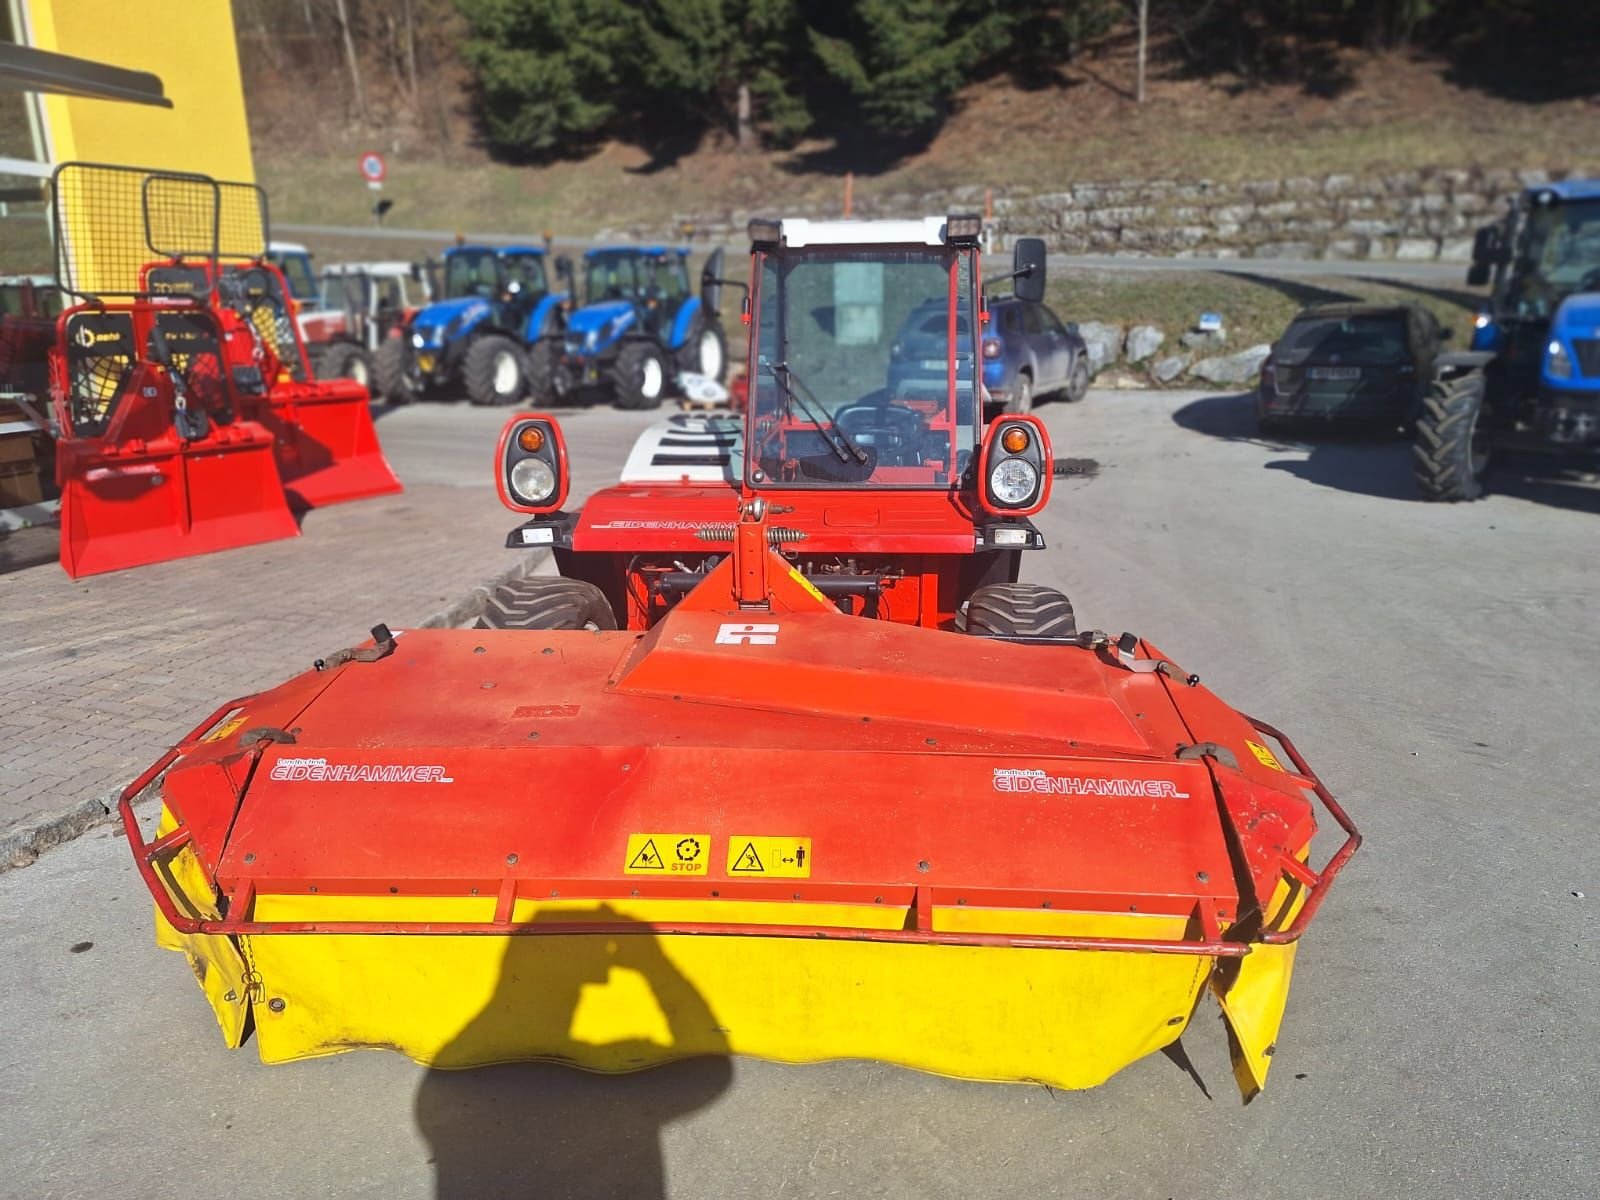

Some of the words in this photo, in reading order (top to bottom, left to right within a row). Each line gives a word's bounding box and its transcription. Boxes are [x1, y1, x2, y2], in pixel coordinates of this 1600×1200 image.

[609, 520, 736, 529] EIDENHAMM
[271, 765, 446, 783] EIDENHAMMER
[993, 775, 1177, 798] EIDENHAMMER
[671, 862, 702, 872] STOP
